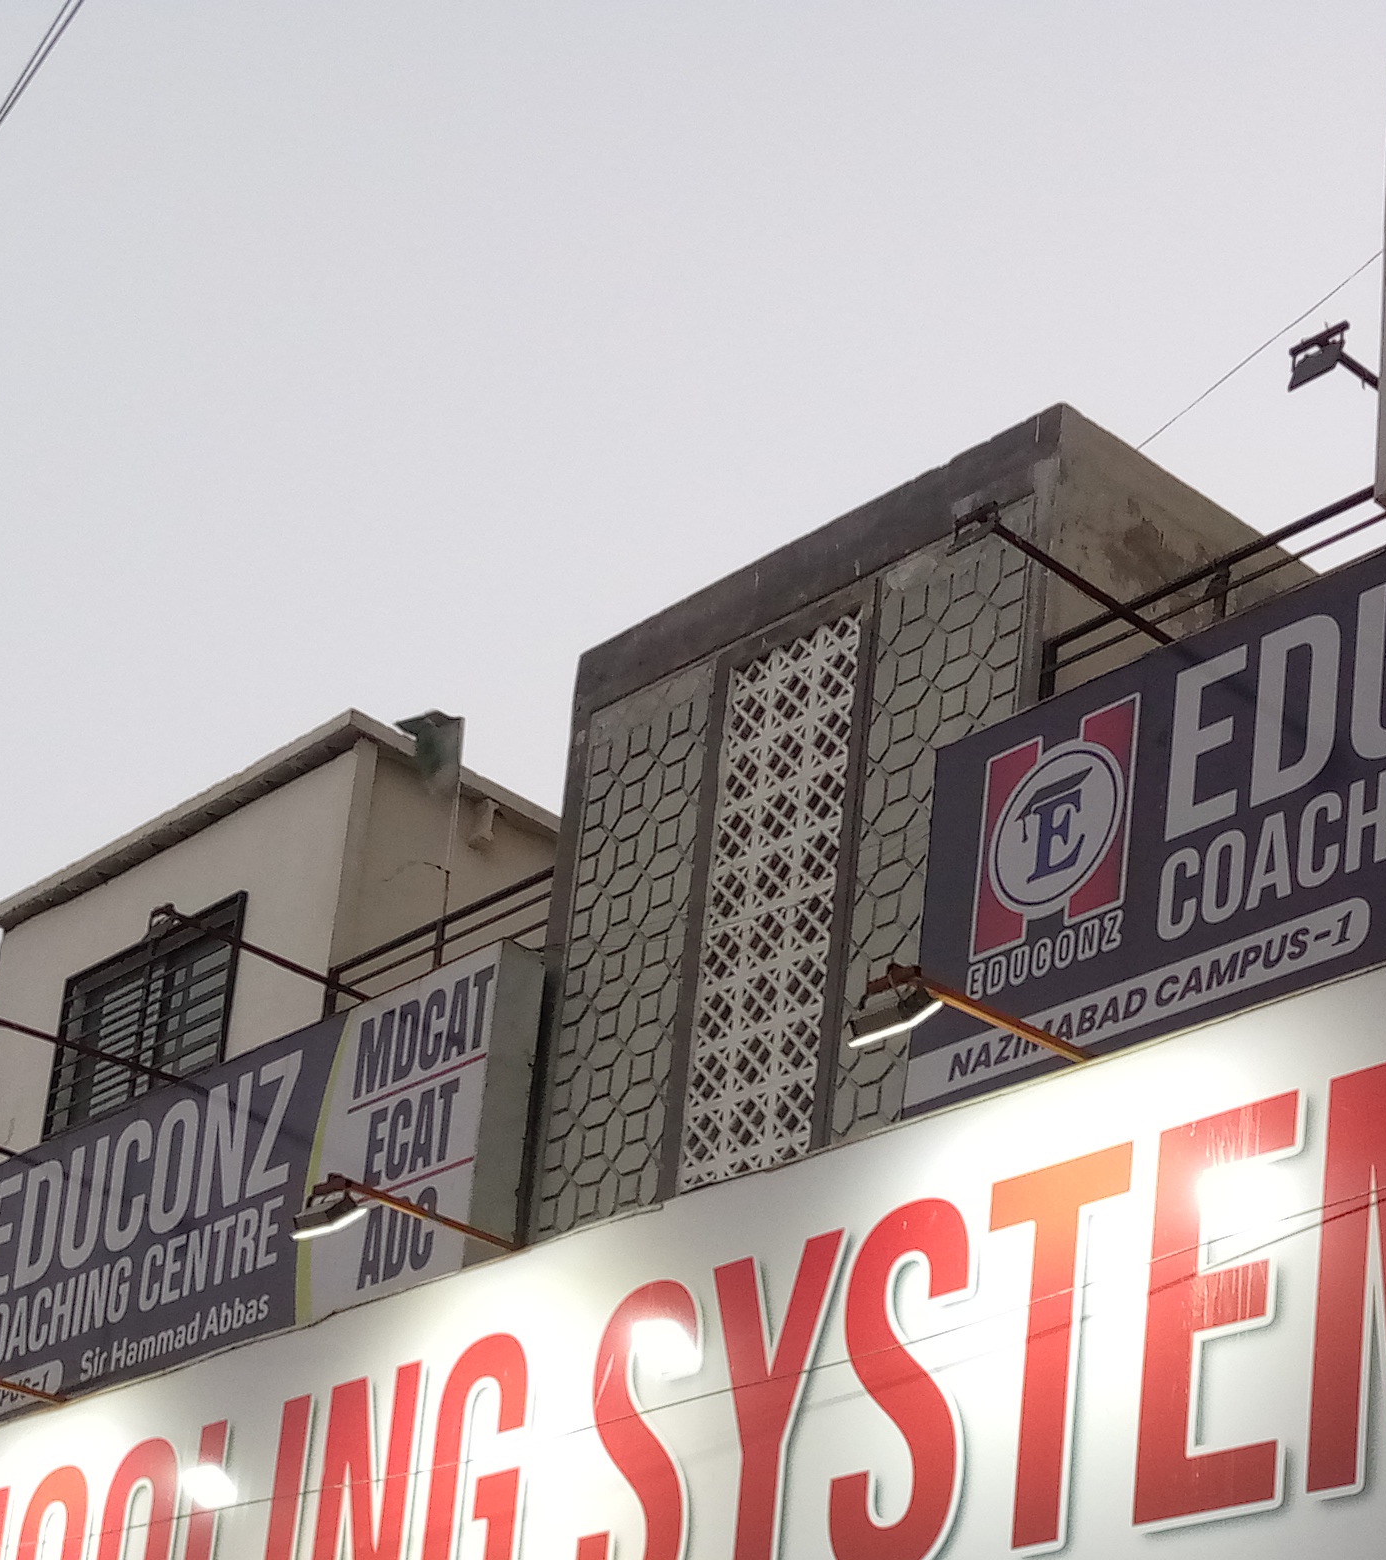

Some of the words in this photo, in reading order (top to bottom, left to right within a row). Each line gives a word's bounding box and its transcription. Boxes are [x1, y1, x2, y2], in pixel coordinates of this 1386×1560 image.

[965, 909, 1124, 1001] EDUCONZ
[352, 963, 495, 1101] MDCAT
[363, 1076, 460, 1190] ECAT
[138, 1194, 285, 1309] CENTRE
[356, 1185, 439, 1291] ADC
[80, 1342, 108, 1382] Sir
[112, 1309, 201, 1368] Hammad
[202, 1292, 270, 1339] Abbas
